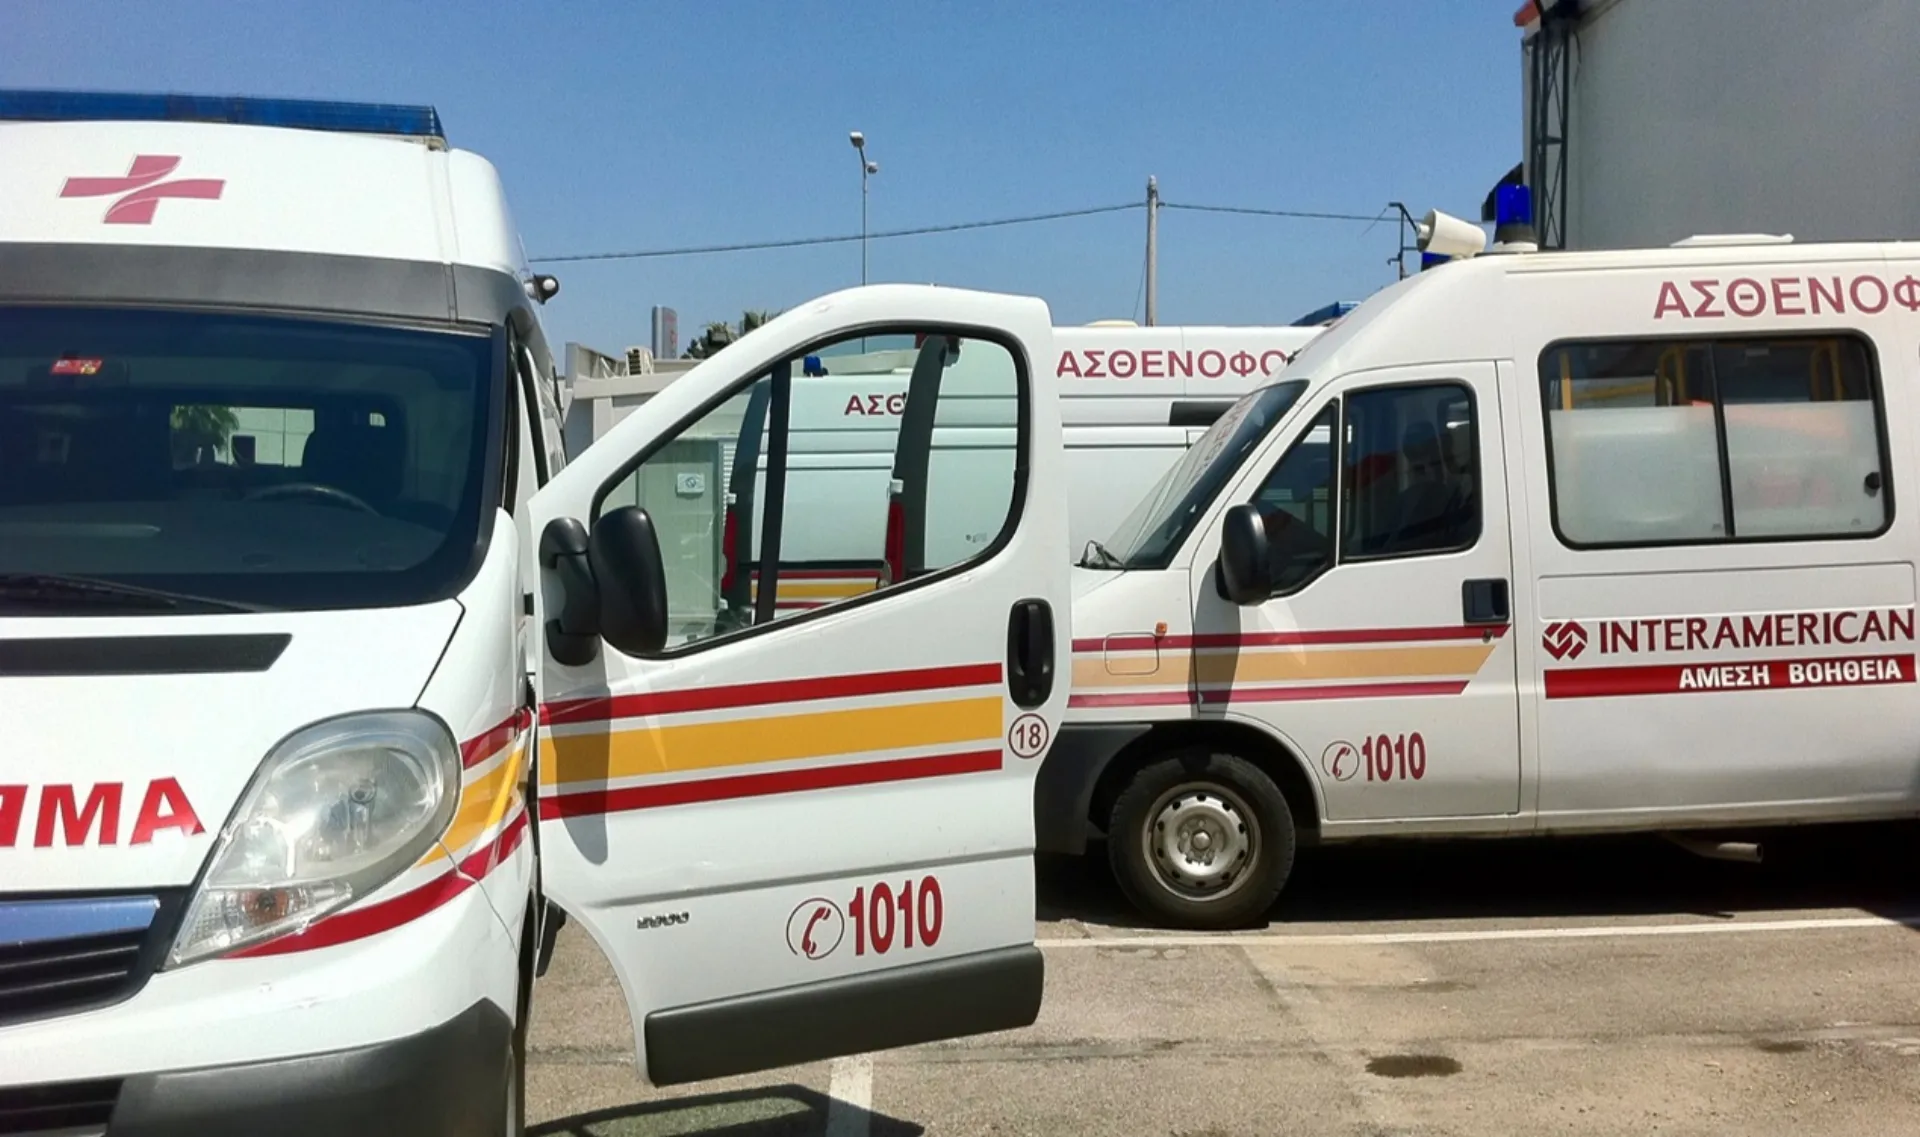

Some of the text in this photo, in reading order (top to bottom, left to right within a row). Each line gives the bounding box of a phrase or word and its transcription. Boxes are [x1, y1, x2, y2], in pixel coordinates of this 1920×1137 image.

[1599, 608, 1915, 654] INTERAMERICAN
[1679, 658, 1903, 690] ΑΜΕΣΗ ΒΟΗΘΕΙΑ
[1015, 722, 1042, 750] 18
[1361, 731, 1427, 783] 1010
[848, 874, 944, 956] 1010
